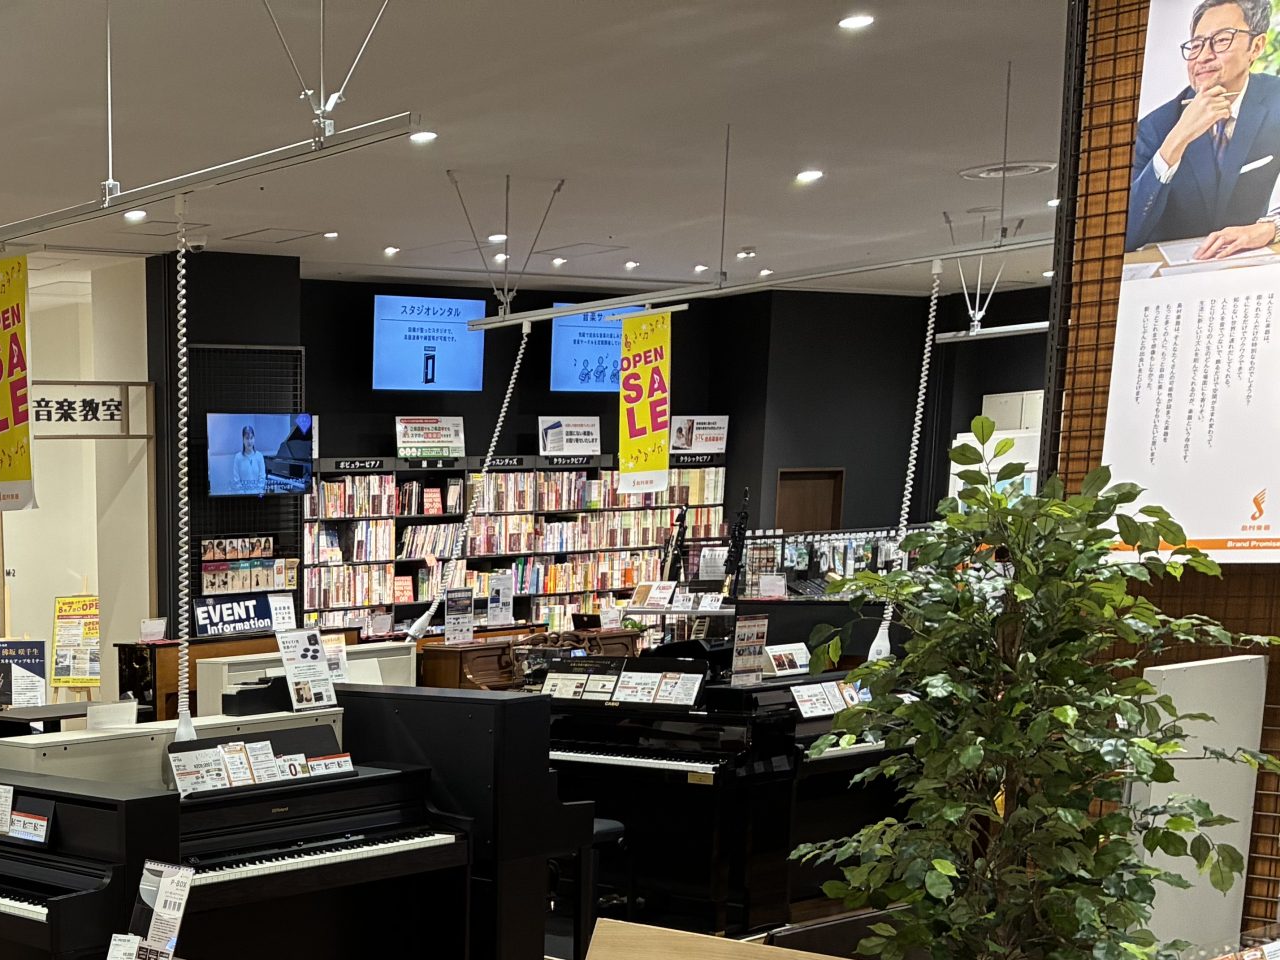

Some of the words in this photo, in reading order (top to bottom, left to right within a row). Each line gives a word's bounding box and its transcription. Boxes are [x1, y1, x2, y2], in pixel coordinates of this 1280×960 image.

[400, 304, 461, 317] スタジオレンタル
[620, 345, 664, 372] OPEN
[622, 366, 668, 406] SA
[33, 397, 123, 423] 音楽教室
[626, 396, 669, 439] LE
[338, 460, 381, 469] ポピュラーピアノ
[487, 457, 518, 466] ッスングッズ
[552, 456, 588, 465] クラシックピアノ
[679, 454, 712, 463] クラシックピアノ
[196, 599, 257, 625] EVENT
[207, 617, 271, 635] Information
